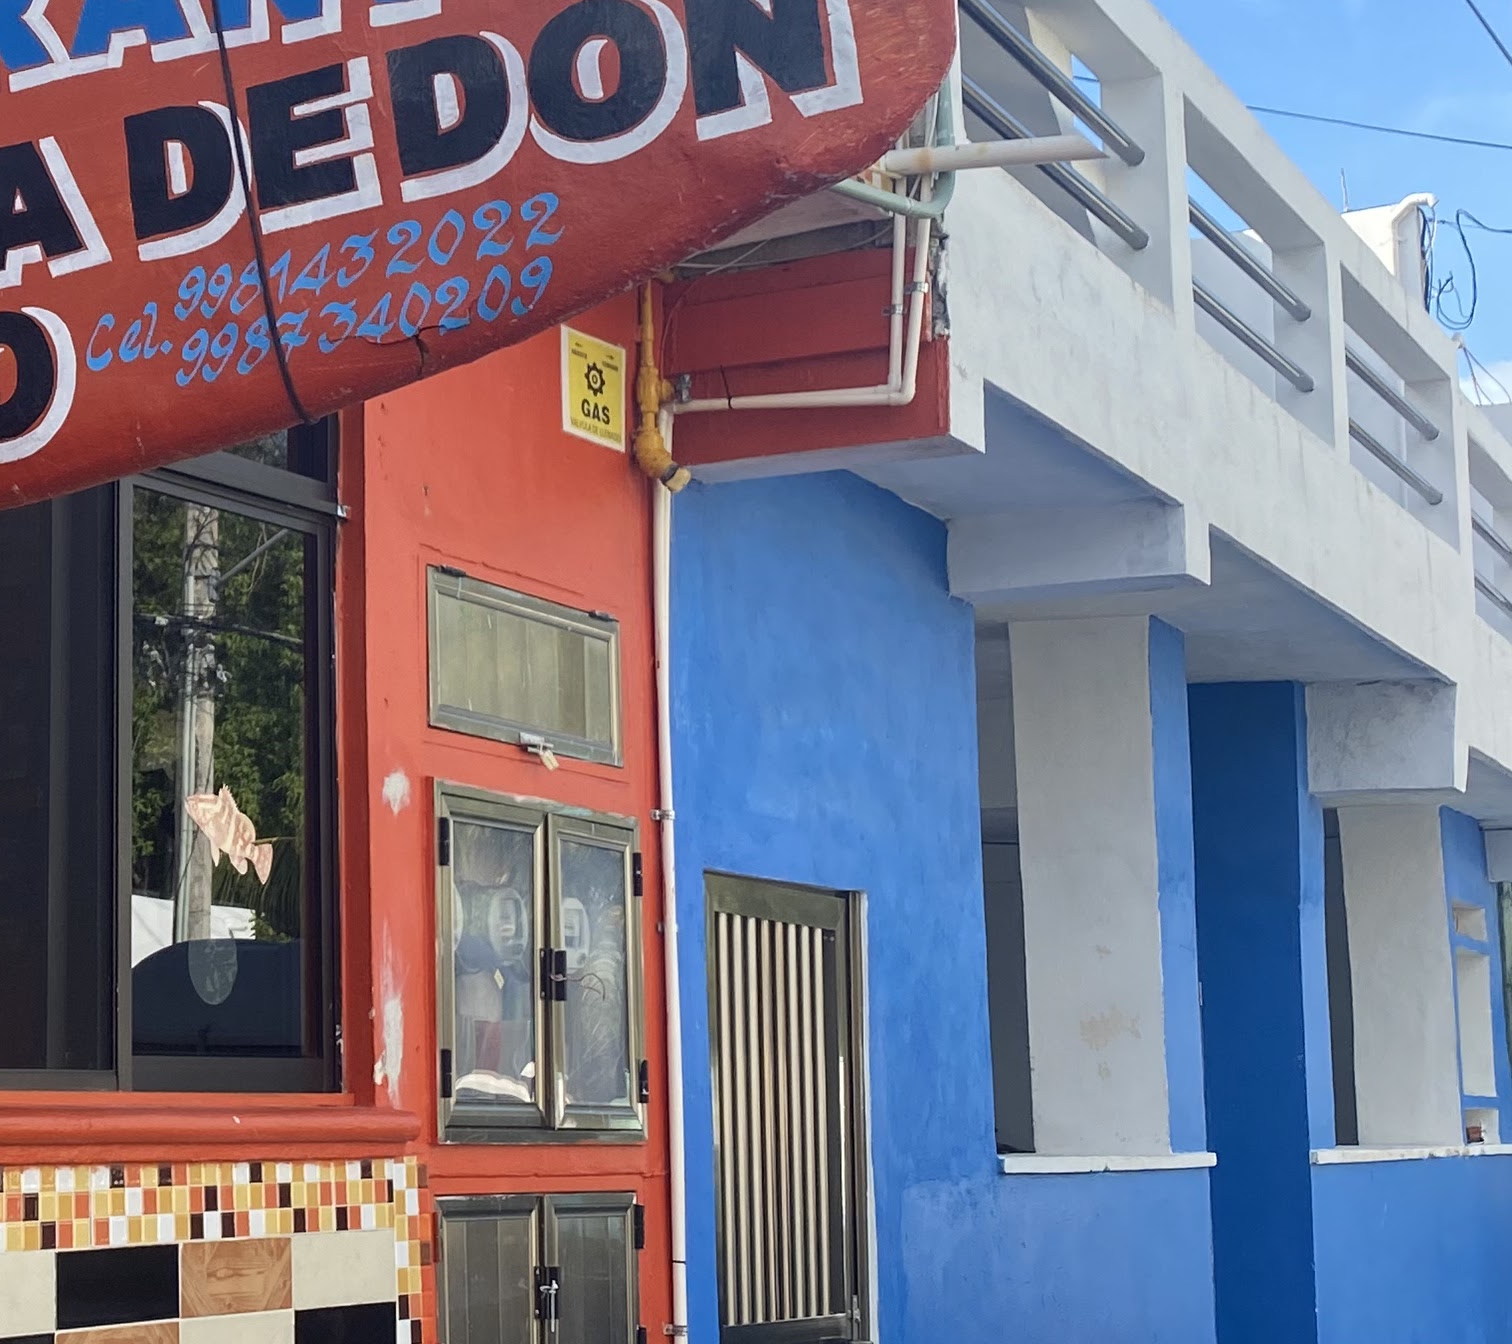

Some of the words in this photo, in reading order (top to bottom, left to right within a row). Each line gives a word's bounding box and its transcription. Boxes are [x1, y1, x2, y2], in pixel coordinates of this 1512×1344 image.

[122, 57, 383, 262] DE
[173, 191, 565, 322] 9981432022
[175, 256, 554, 387] 9987340209
[581, 398, 610, 425] GAS
